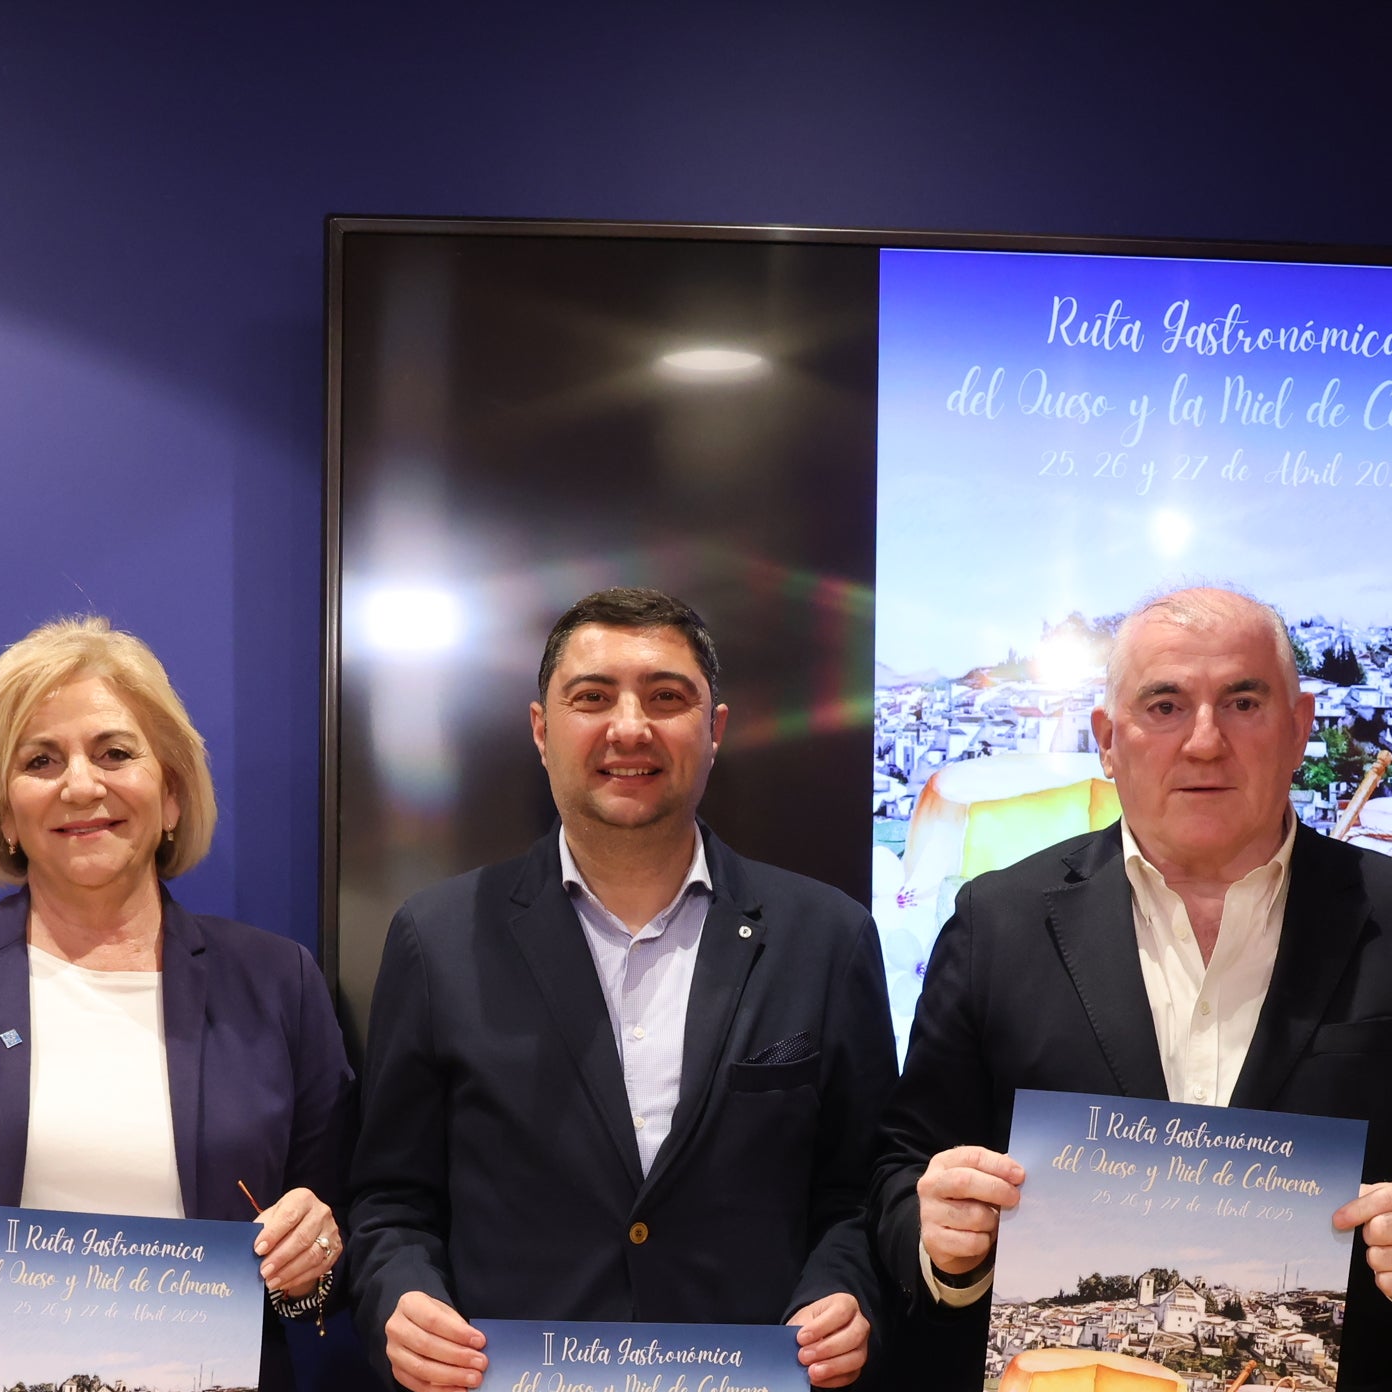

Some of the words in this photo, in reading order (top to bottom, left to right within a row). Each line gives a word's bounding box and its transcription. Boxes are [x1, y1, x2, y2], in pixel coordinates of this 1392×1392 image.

[1047, 296, 1144, 352] Ruta
[946, 365, 1005, 420] del
[1018, 368, 1115, 424] Queso
[1120, 395, 1156, 447] y
[1168, 373, 1206, 427] la
[1219, 375, 1293, 429] Miel
[1306, 378, 1350, 428] de
[1092, 452, 1128, 478] 26
[1136, 460, 1159, 496] y
[1171, 455, 1208, 481] 27
[1221, 449, 1250, 481] de
[1263, 450, 1343, 487] Abril
[1106, 1111, 1157, 1145] Ruta
[1163, 1117, 1295, 1158] Gastronómica
[1052, 1144, 1081, 1173] del
[1140, 1164, 1160, 1192] y
[1166, 1155, 1209, 1185] Miel
[1212, 1160, 1235, 1187] de
[1241, 1163, 1324, 1197] Colmenar
[1142, 1198, 1153, 1216] y
[1186, 1195, 1201, 1212] de
[25, 1224, 75, 1255] Ruta
[80, 1227, 205, 1263] Gastronómica
[62, 1272, 79, 1301] y
[85, 1264, 121, 1293] Miel
[129, 1267, 151, 1293] de
[157, 1269, 234, 1298] Colmenar
[62, 1307, 72, 1324] y
[105, 1302, 119, 1318] de
[561, 1337, 611, 1364] Ruta
[617, 1337, 743, 1368] Gastronómica
